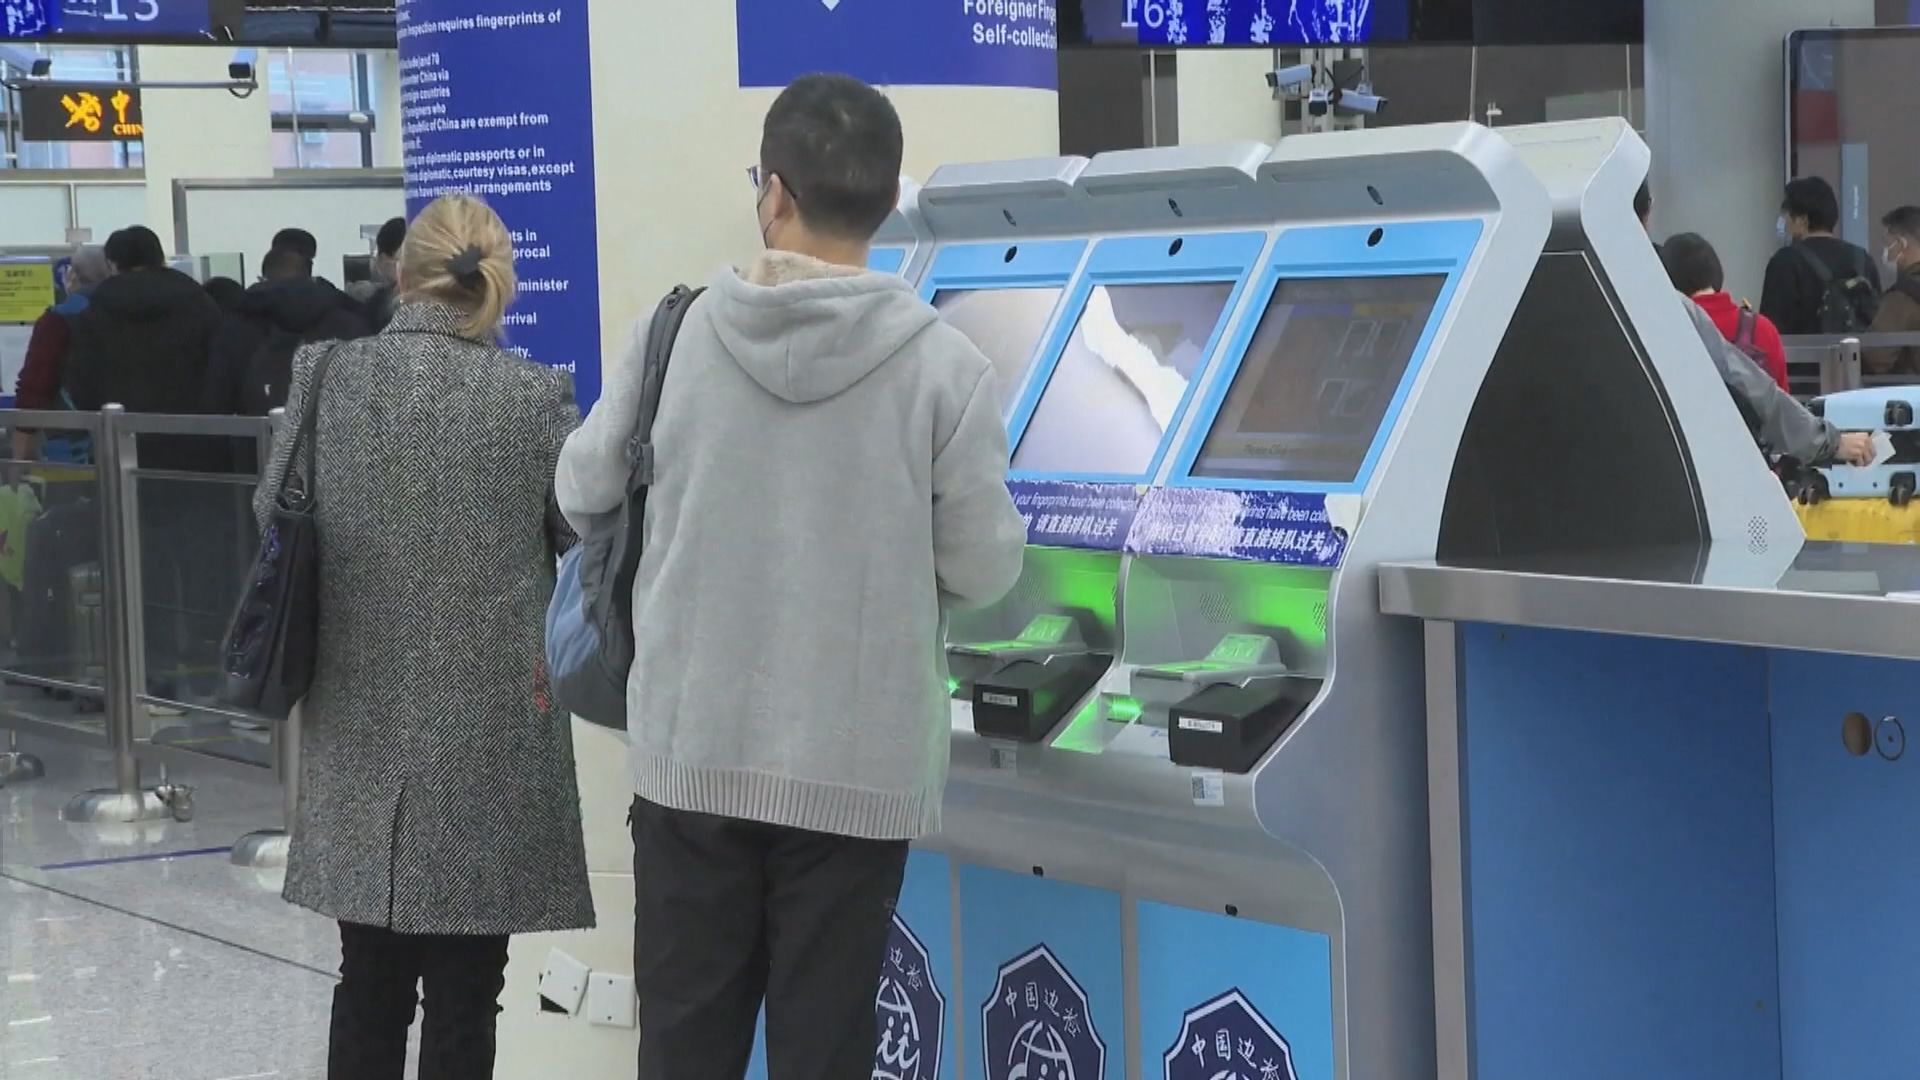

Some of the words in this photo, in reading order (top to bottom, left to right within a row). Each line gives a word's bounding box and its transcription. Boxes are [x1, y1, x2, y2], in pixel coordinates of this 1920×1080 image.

[963, 0, 1037, 21] Foreigner
[1121, 0, 1164, 28] 16
[438, 17, 474, 33] requires
[476, 11, 545, 30] fingerprints
[547, 8, 561, 23] of
[437, 117, 460, 130] China
[461, 118, 476, 129] are
[478, 113, 518, 129] exempt
[519, 112, 549, 125] from
[463, 147, 516, 164] passports
[518, 147, 531, 159] or
[533, 144, 545, 158] in
[474, 180, 553, 195] arrangements
[525, 228, 537, 242] in
[518, 279, 569, 292] minister
[1031, 492, 1069, 509] fingerprints
[1068, 494, 1087, 508] have
[1086, 495, 1105, 508] been
[1287, 506, 1310, 521] been
